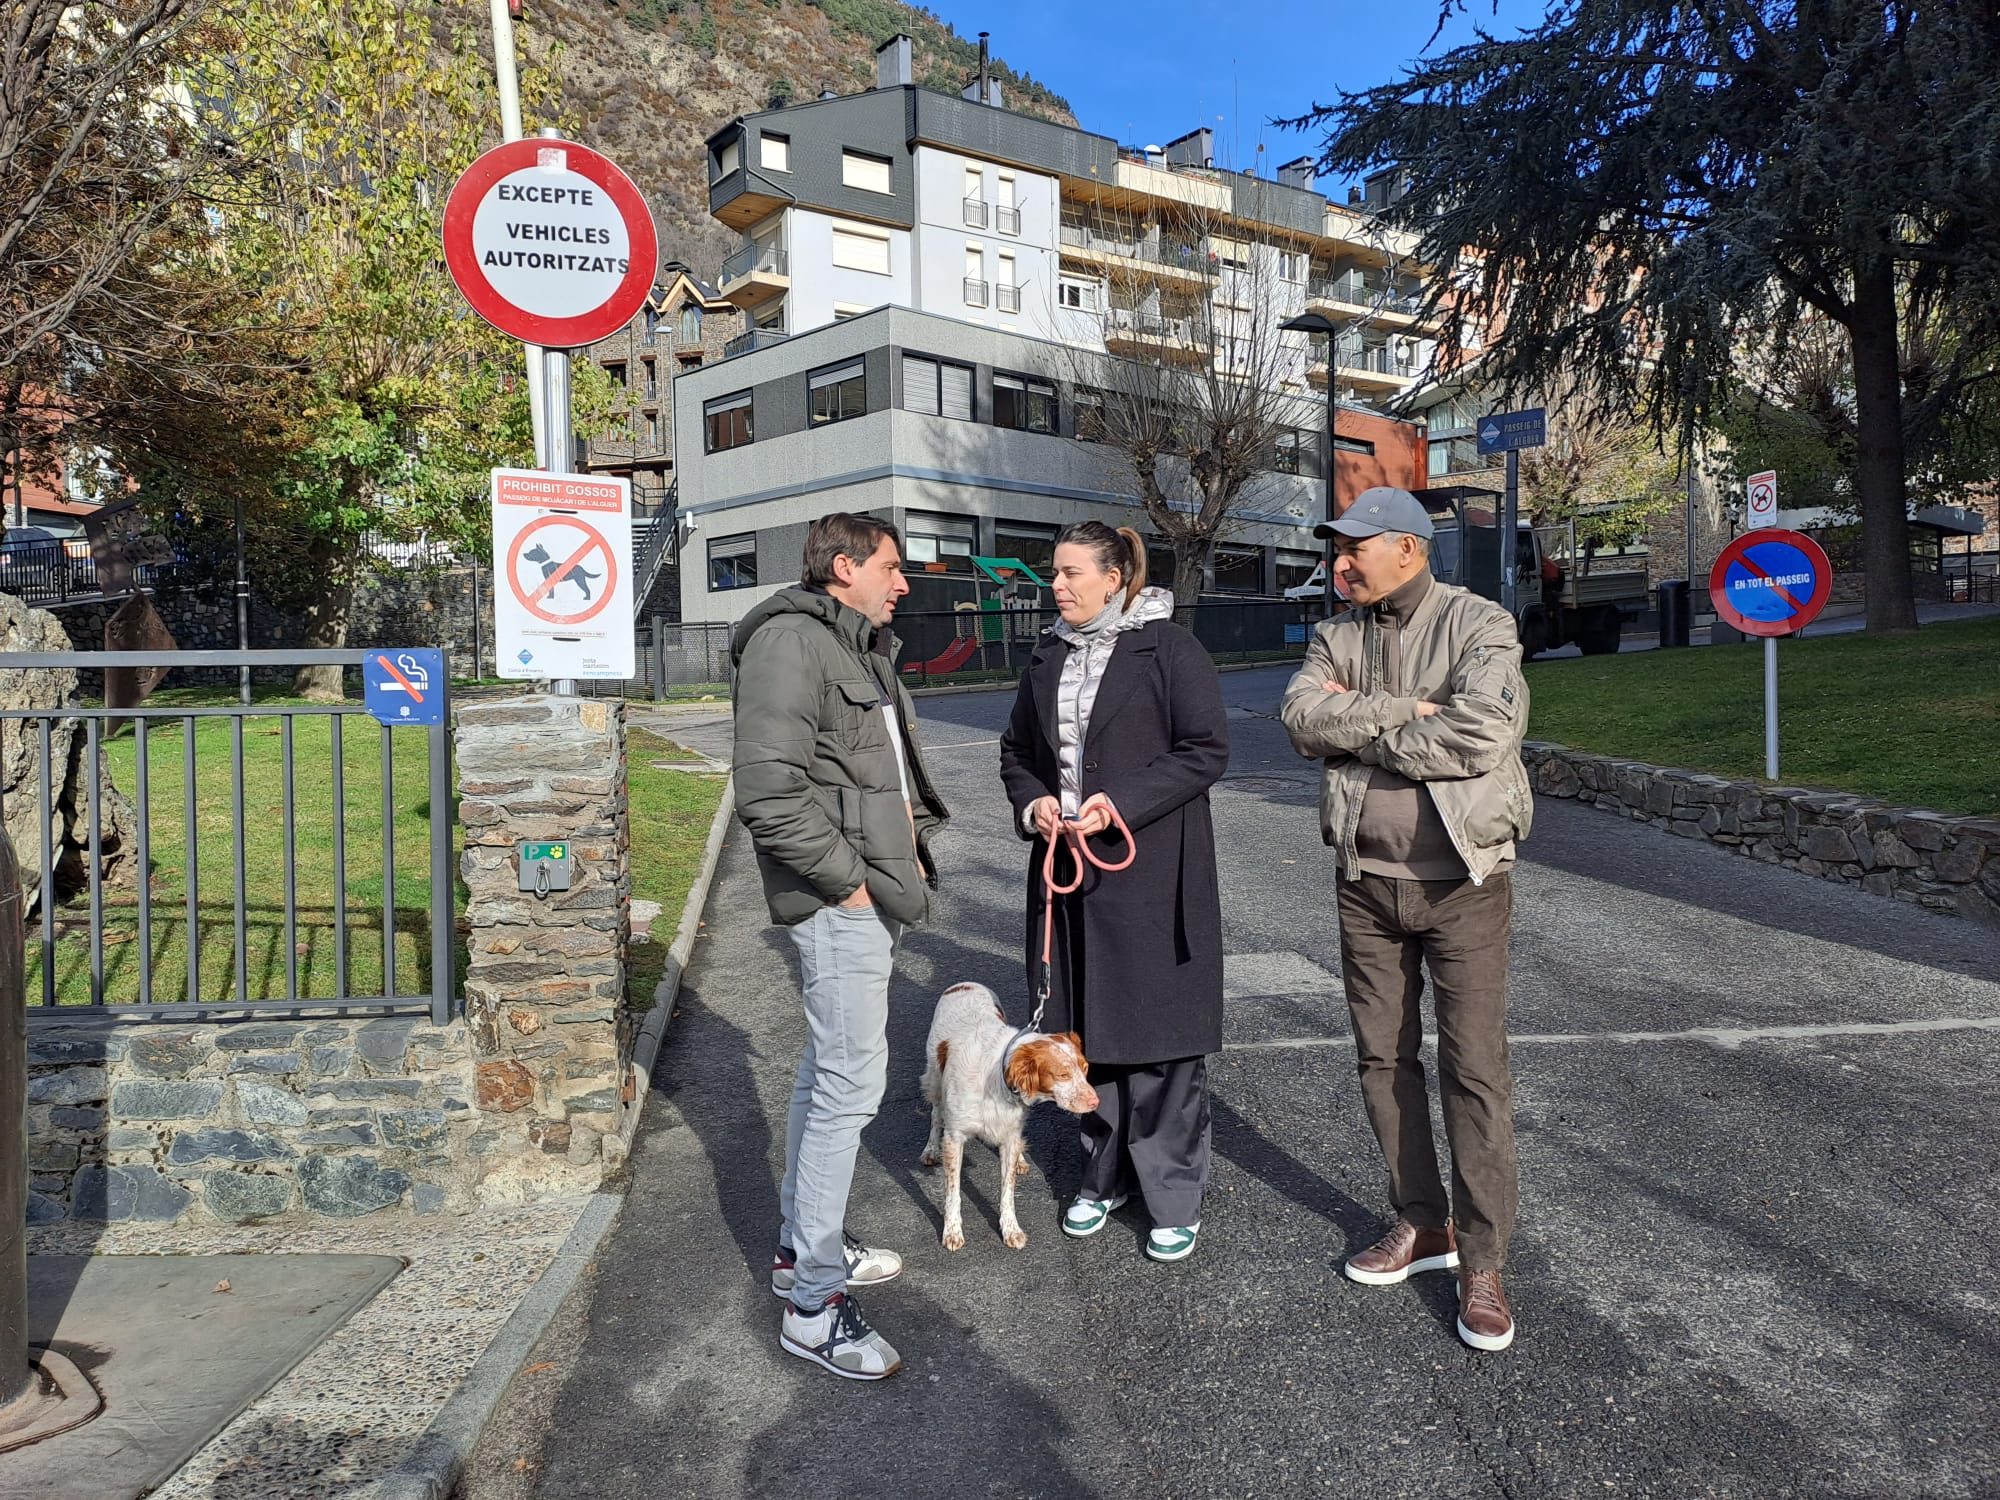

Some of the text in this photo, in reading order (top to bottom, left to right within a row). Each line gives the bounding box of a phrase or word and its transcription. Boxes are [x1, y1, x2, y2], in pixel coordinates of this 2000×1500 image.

[498, 184, 593, 206] EXCEPTE
[506, 223, 610, 244] VEHICLES
[484, 250, 630, 274] AUTORITZATS
[1504, 419, 1542, 432] PASSEIG DE
[503, 480, 617, 498] PROHIBIT GOSSOS
[503, 493, 531, 502] PASSEIG
[1735, 573, 1810, 590] EN TOT EL PASSEIG
[529, 845, 540, 859] P
